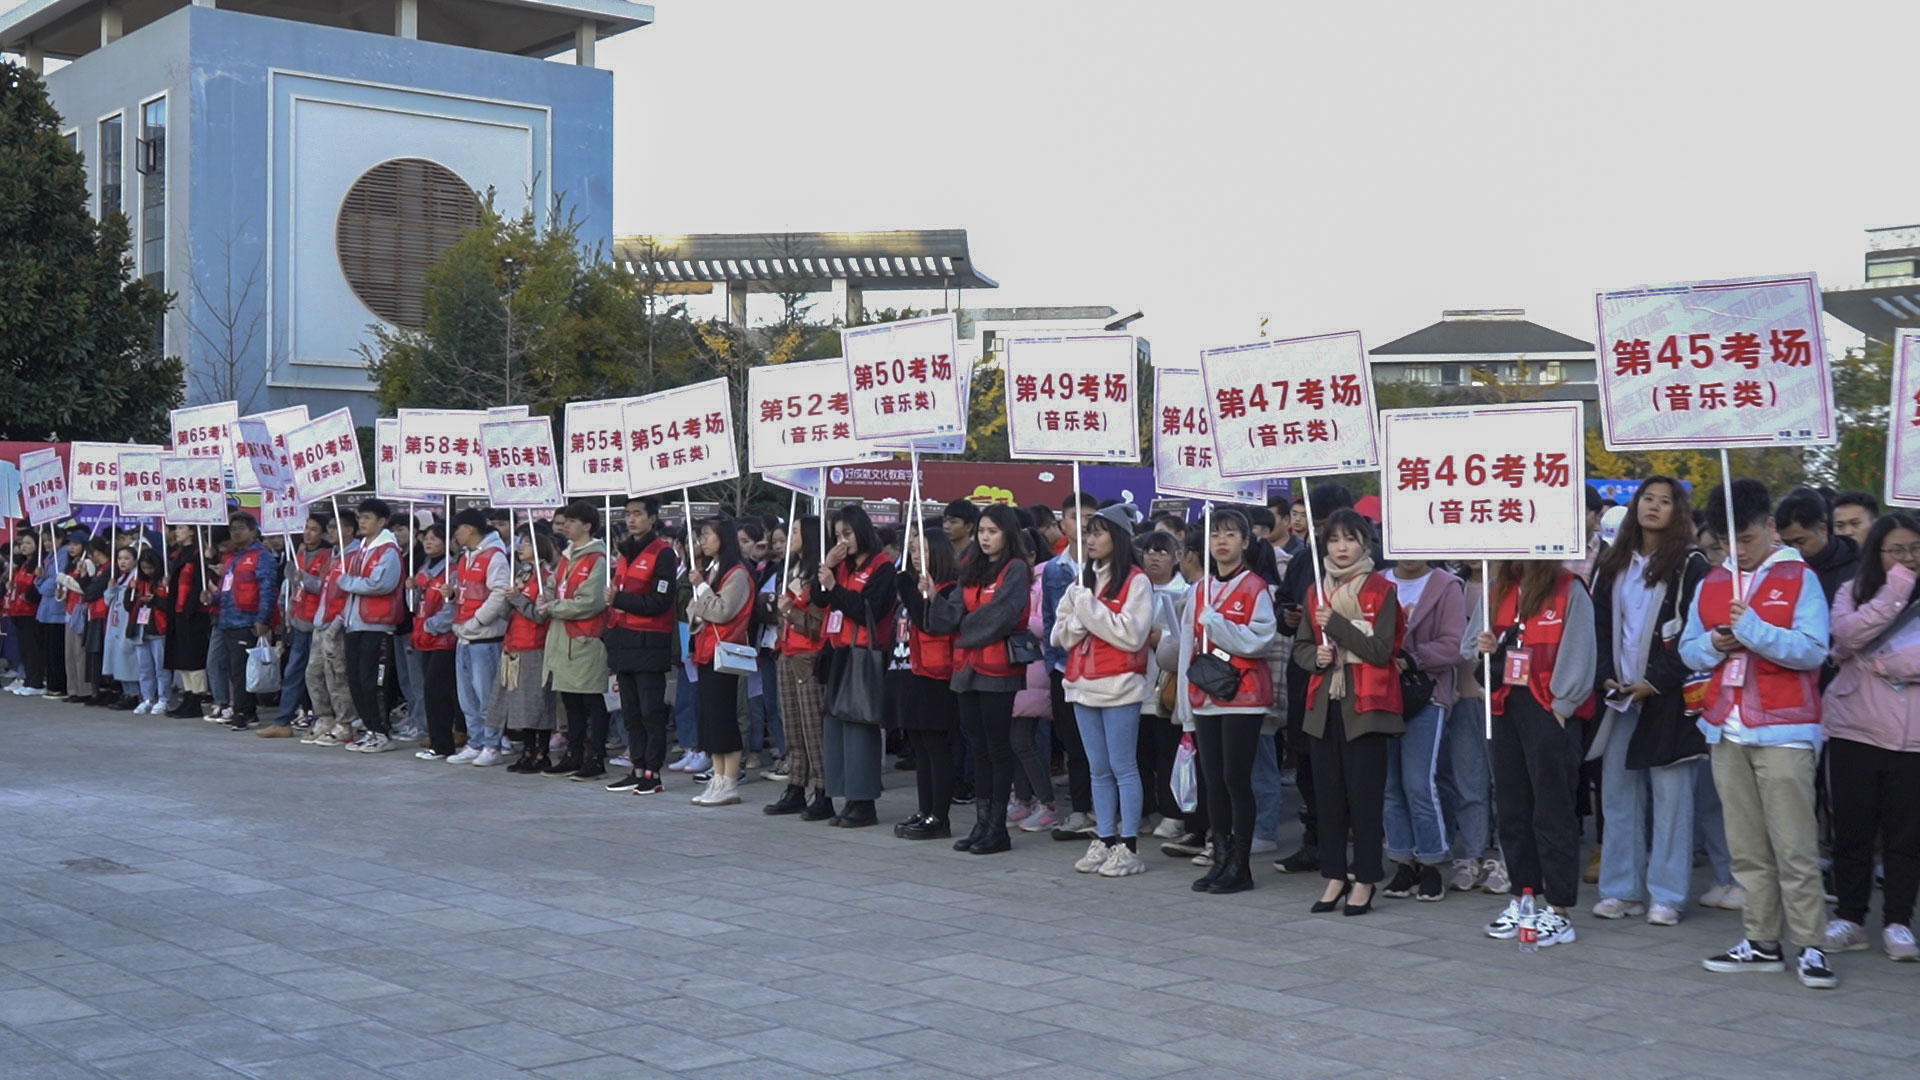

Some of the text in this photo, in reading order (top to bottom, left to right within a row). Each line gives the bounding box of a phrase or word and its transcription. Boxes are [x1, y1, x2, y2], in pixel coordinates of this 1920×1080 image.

[1612, 328, 1813, 377] 第45考场
[853, 353, 952, 391] 第50考场
[1015, 372, 1128, 403] 第49考场
[1216, 373, 1362, 420] 第47考场
[1652, 380, 1778, 412] (音乐类)
[874, 390, 936, 416] (音乐类)
[630, 412, 725, 451] 第54考场
[1037, 410, 1107, 432] (音乐类)
[1248, 418, 1338, 448] (音乐类)
[292, 434, 353, 470] 第60考场
[487, 447, 551, 468] 第56考场
[650, 444, 710, 470] (音乐类)
[308, 460, 345, 484] (音乐类)
[419, 461, 473, 476] (音乐类)
[502, 473, 543, 488] (音乐类)
[1397, 452, 1570, 491] 第46考场
[165, 477, 221, 495] 第64考场
[177, 496, 212, 510] (音乐类)
[1428, 498, 1536, 525] (音乐类)
